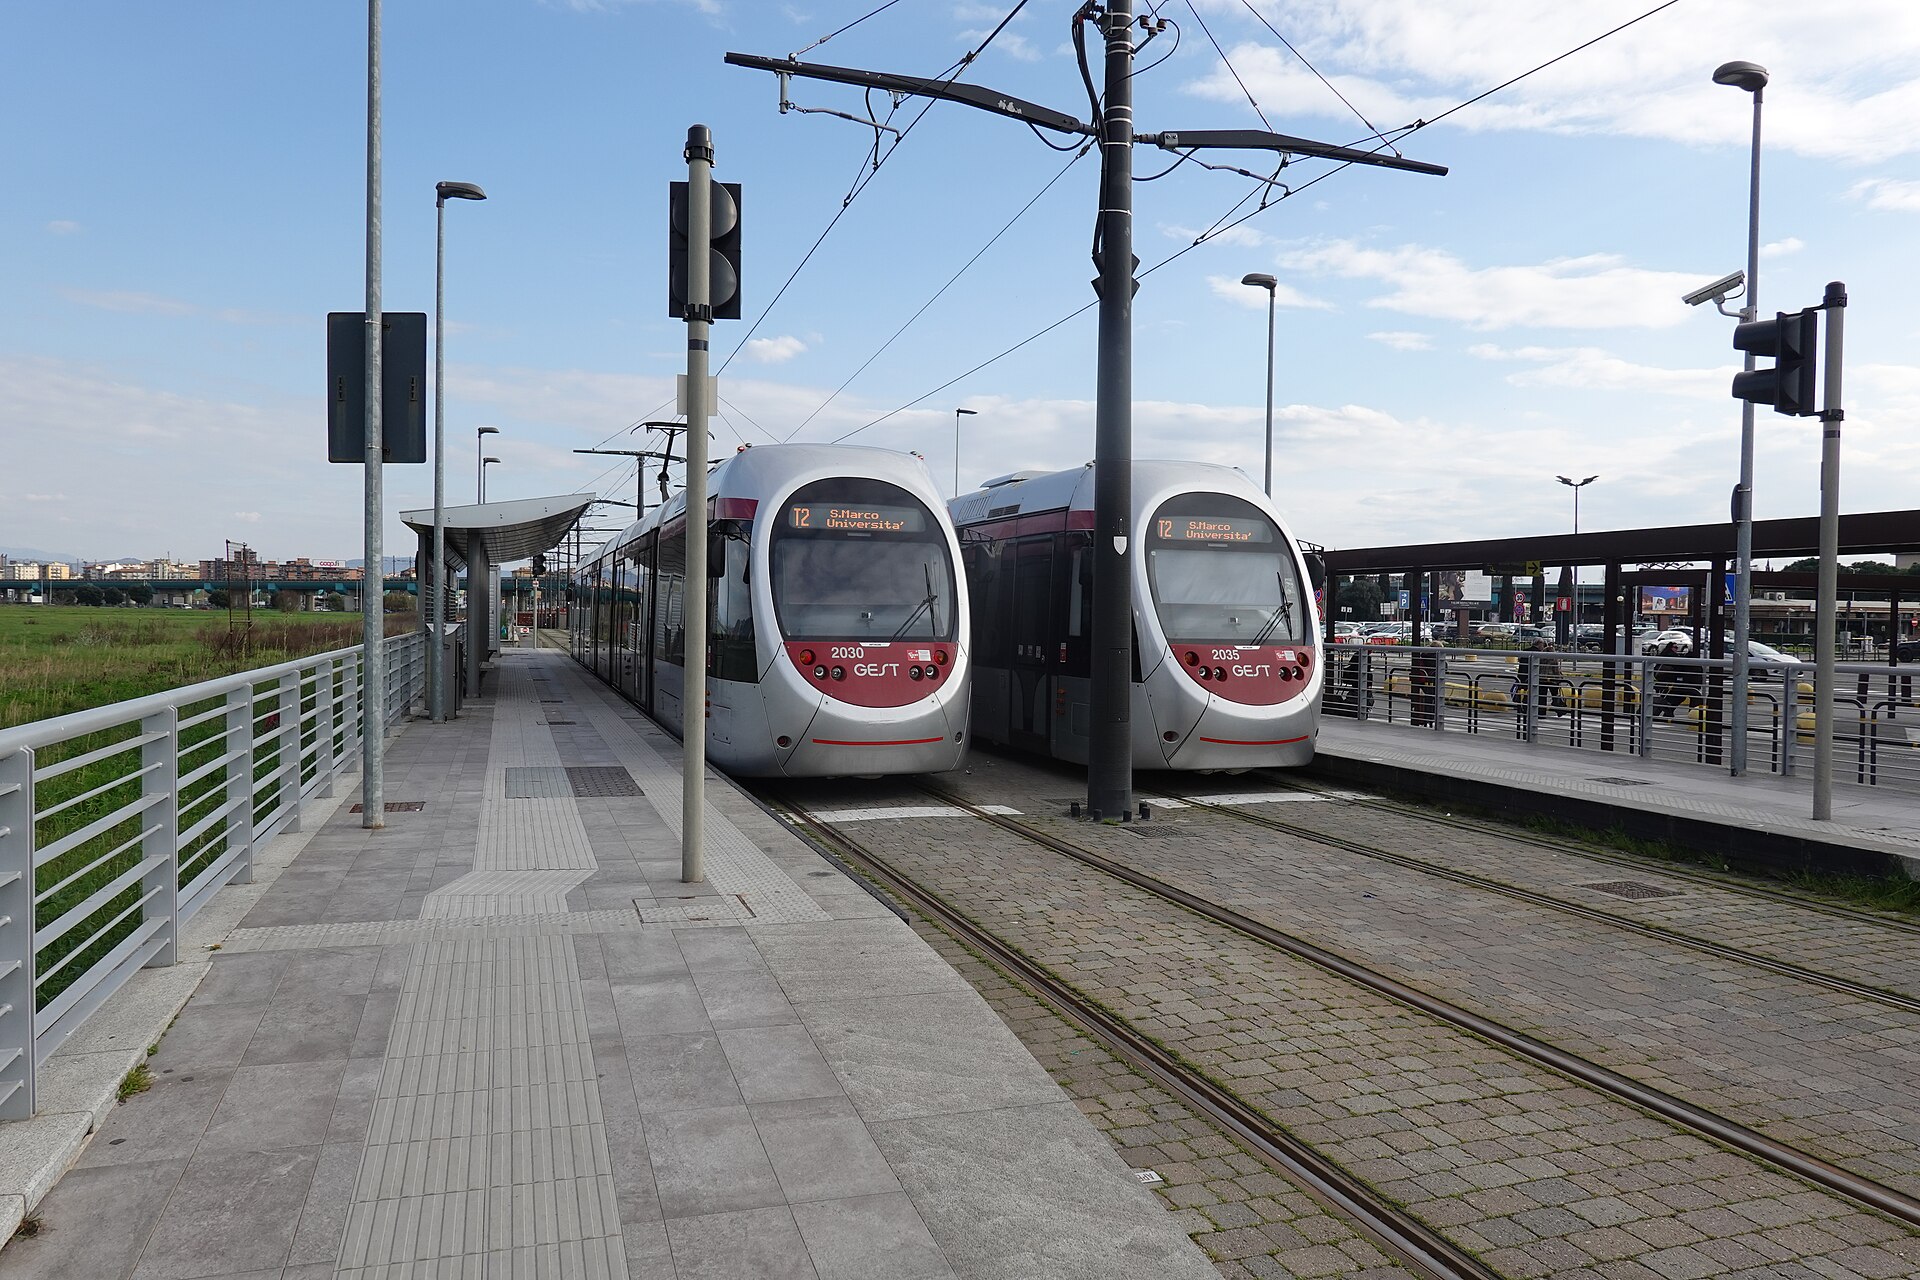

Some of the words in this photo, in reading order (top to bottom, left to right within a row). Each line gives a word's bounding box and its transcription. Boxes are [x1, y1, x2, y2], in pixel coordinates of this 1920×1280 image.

[793, 508, 810, 527] T2
[830, 509, 879, 520] S.Marco
[826, 518, 904, 530] Universita'
[1158, 520, 1172, 538] T2
[1189, 521, 1231, 531] S.Marco
[1186, 530, 1252, 540] Universita'
[1401, 599, 1407, 607] P
[831, 646, 865, 659] 2030
[1211, 649, 1240, 660] 2035
[853, 663, 900, 677] GEST
[1232, 664, 1270, 677] GEST
